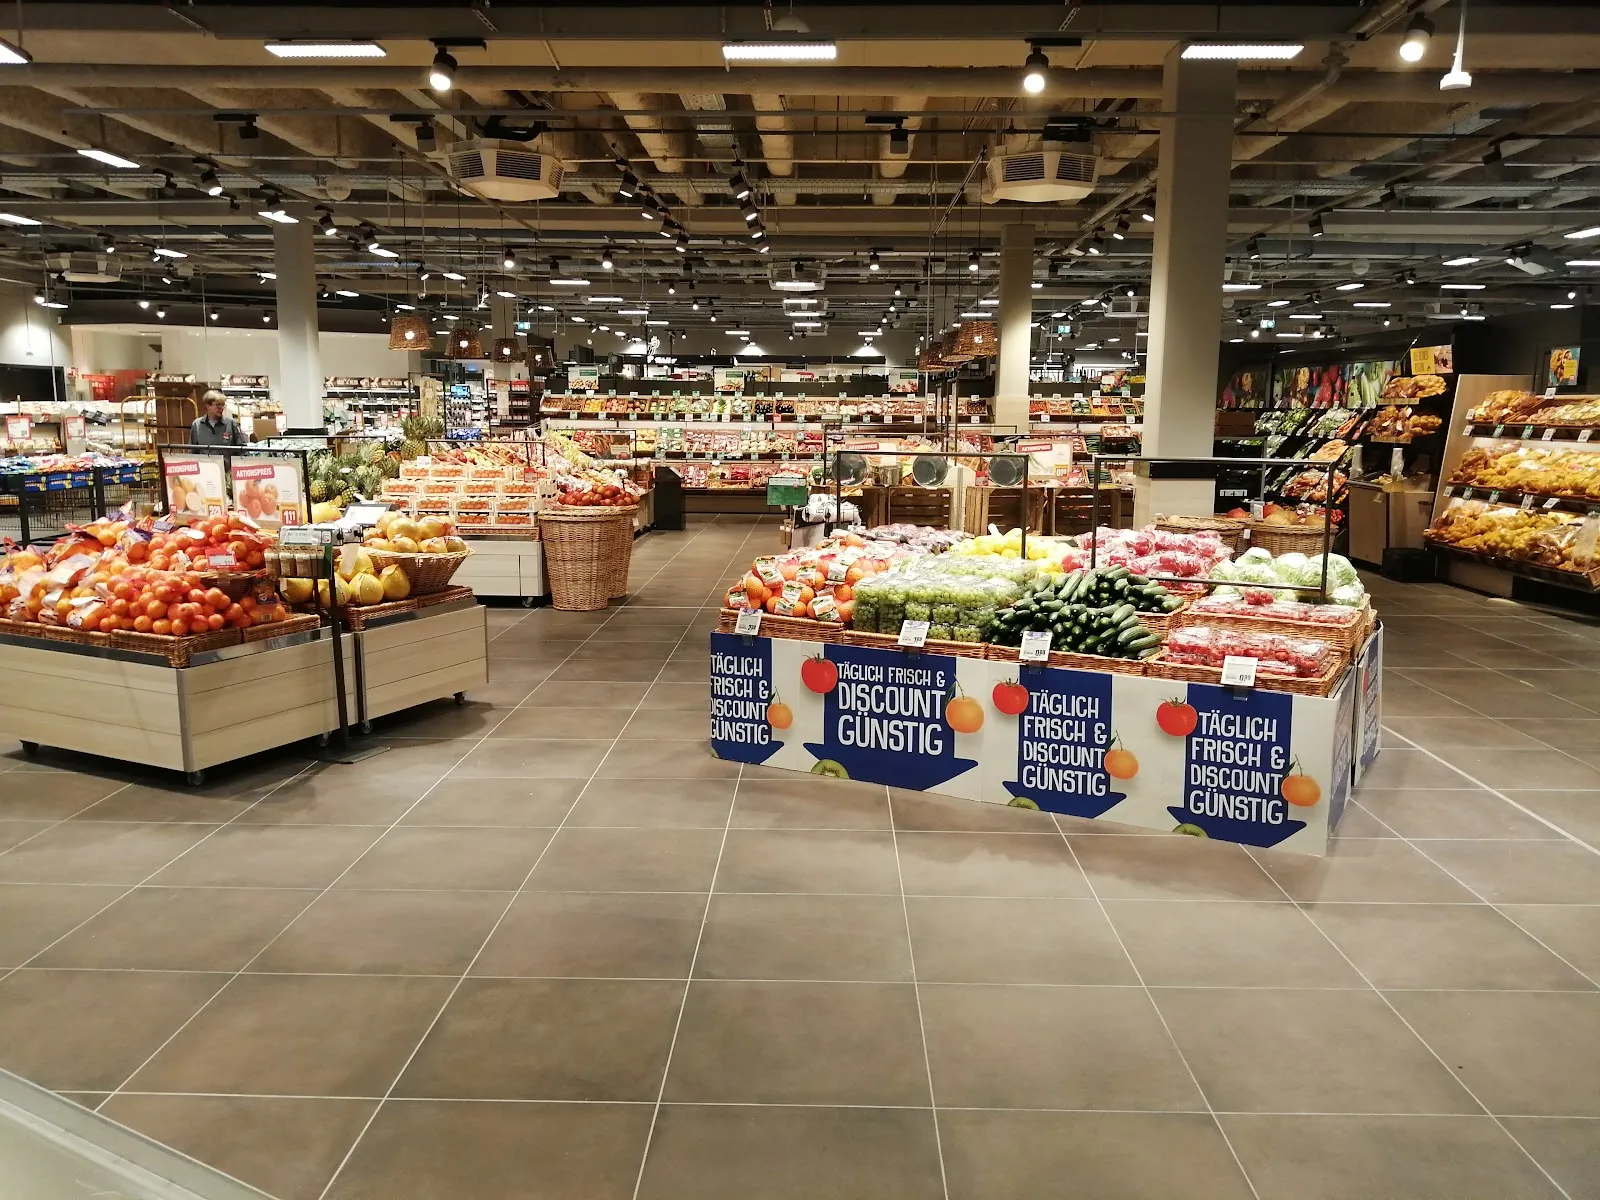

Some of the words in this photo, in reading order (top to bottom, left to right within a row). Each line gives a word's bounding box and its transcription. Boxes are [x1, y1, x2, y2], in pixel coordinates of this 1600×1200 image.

[166, 463, 198, 474] AKTIONSPREIS
[235, 467, 273, 478] AKTIONSPREIS
[710, 652, 763, 678] TÄGLICH
[836, 661, 884, 683] TÄGLICH
[888, 666, 931, 687] FRISCH
[936, 670, 946, 688] &
[758, 679, 770, 700] &
[838, 681, 947, 720] DISCOUNT
[1029, 689, 1099, 719] TÄGLICH
[710, 717, 769, 745] GÜNSTIG
[837, 711, 944, 756] GÜNSTIG
[1023, 715, 1086, 743] FRISCH
[1093, 722, 1108, 745] &
[1198, 709, 1277, 743] TÄGLICH
[1023, 740, 1106, 769] DISCOUNT
[1191, 737, 1262, 768] FRISCH
[1270, 745, 1286, 770] &
[1022, 763, 1107, 797] GÜNSTIG
[1190, 763, 1284, 796] DISCOUNT
[1189, 787, 1284, 825] GÜNSTIG
